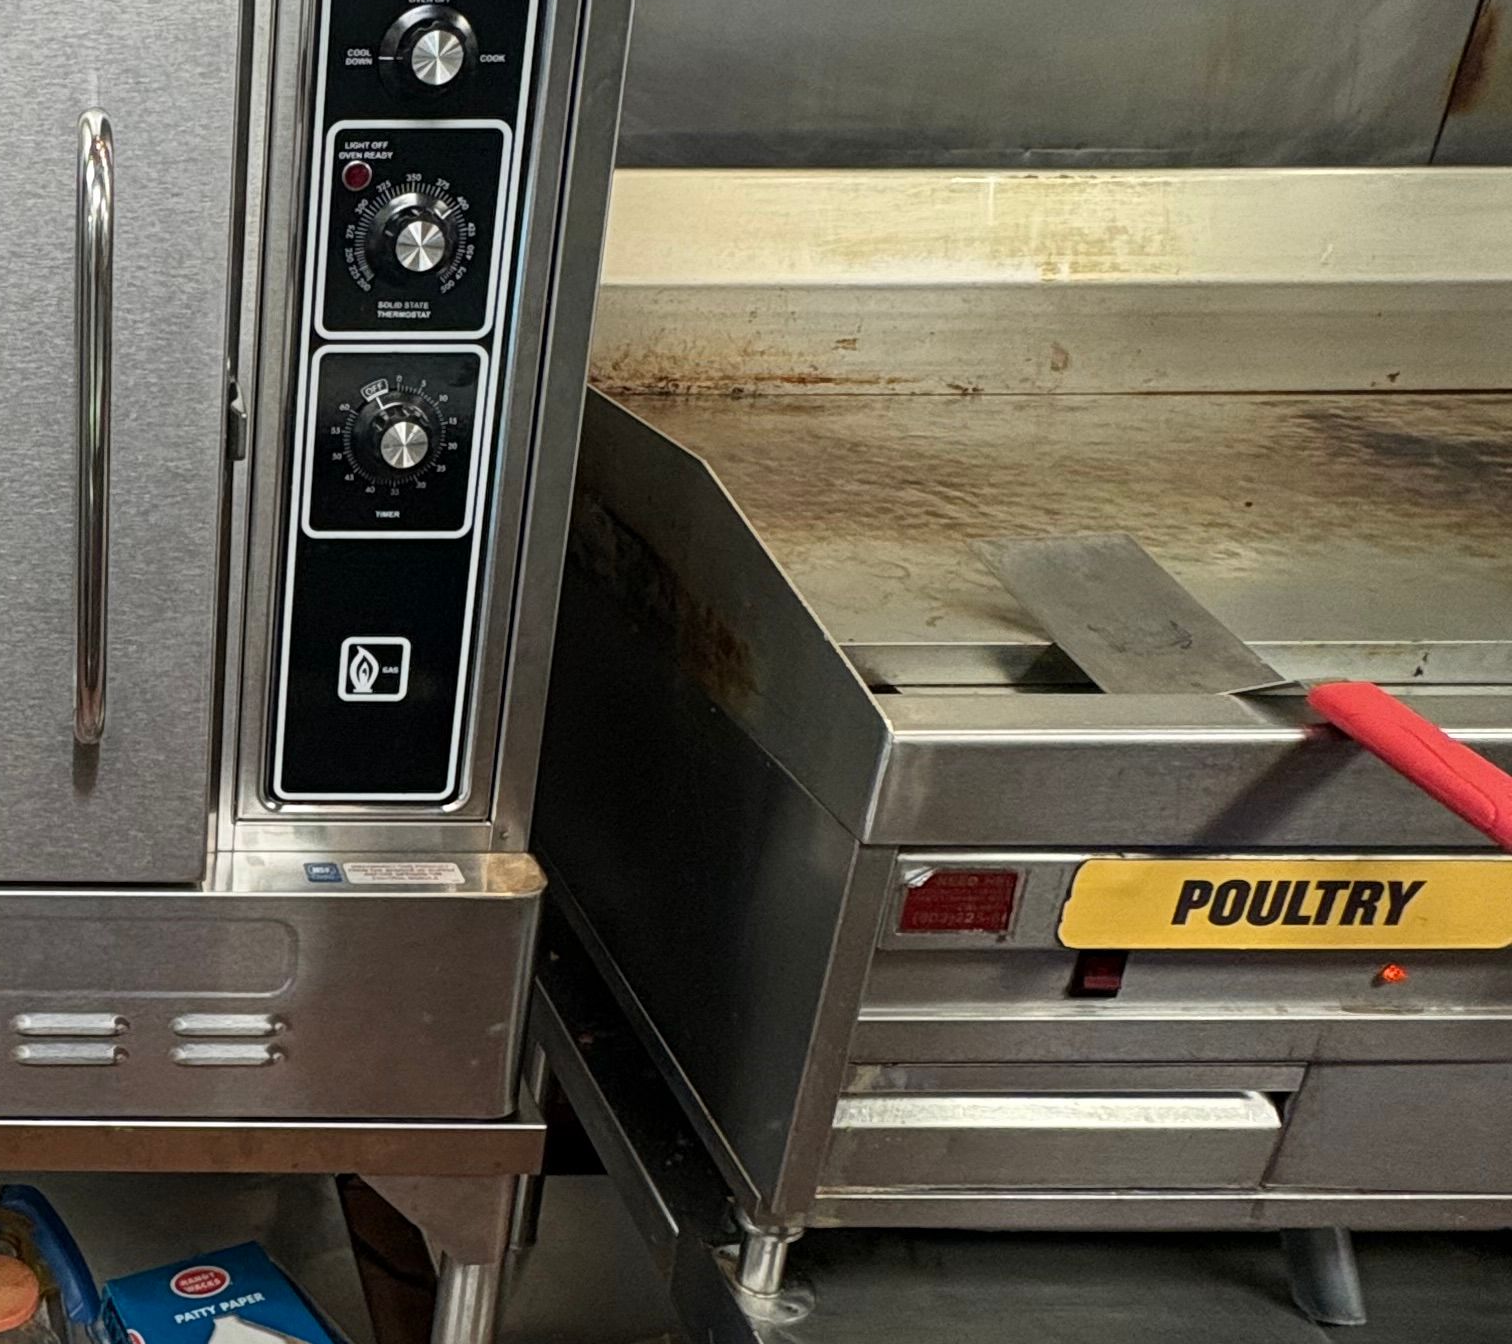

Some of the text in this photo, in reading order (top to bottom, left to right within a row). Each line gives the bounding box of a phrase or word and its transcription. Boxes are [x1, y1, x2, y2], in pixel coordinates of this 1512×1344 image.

[347, 48, 372, 57] COOL
[345, 57, 373, 66] DOWN
[479, 54, 506, 63] COOK
[344, 141, 389, 150] LIGHT OFF
[338, 151, 394, 160] OVEN READY
[406, 173, 423, 182] 350
[375, 179, 391, 193] 325
[435, 177, 450, 191] 375
[354, 198, 369, 215] 300
[456, 196, 470, 211] 400
[345, 224, 356, 240] 275
[344, 247, 355, 264] 250
[348, 264, 361, 280] 225
[356, 277, 372, 293] 200
[440, 279, 456, 294] 500
[377, 301, 430, 310] SOLID STATE
[377, 310, 432, 319] THERMOSTAT
[396, 375, 403, 383] 0
[421, 379, 427, 388] 5
[364, 382, 384, 396] OFF
[439, 394, 449, 402] 10
[339, 403, 351, 412] 60
[449, 417, 458, 425] 15
[448, 442, 458, 451] 20
[365, 485, 376, 494] 40
[375, 510, 401, 518] TIMER
[382, 666, 400, 674] GAS
[1170, 879, 1428, 926] POULTRY
[173, 1292, 266, 1324] PATTY PAPER
